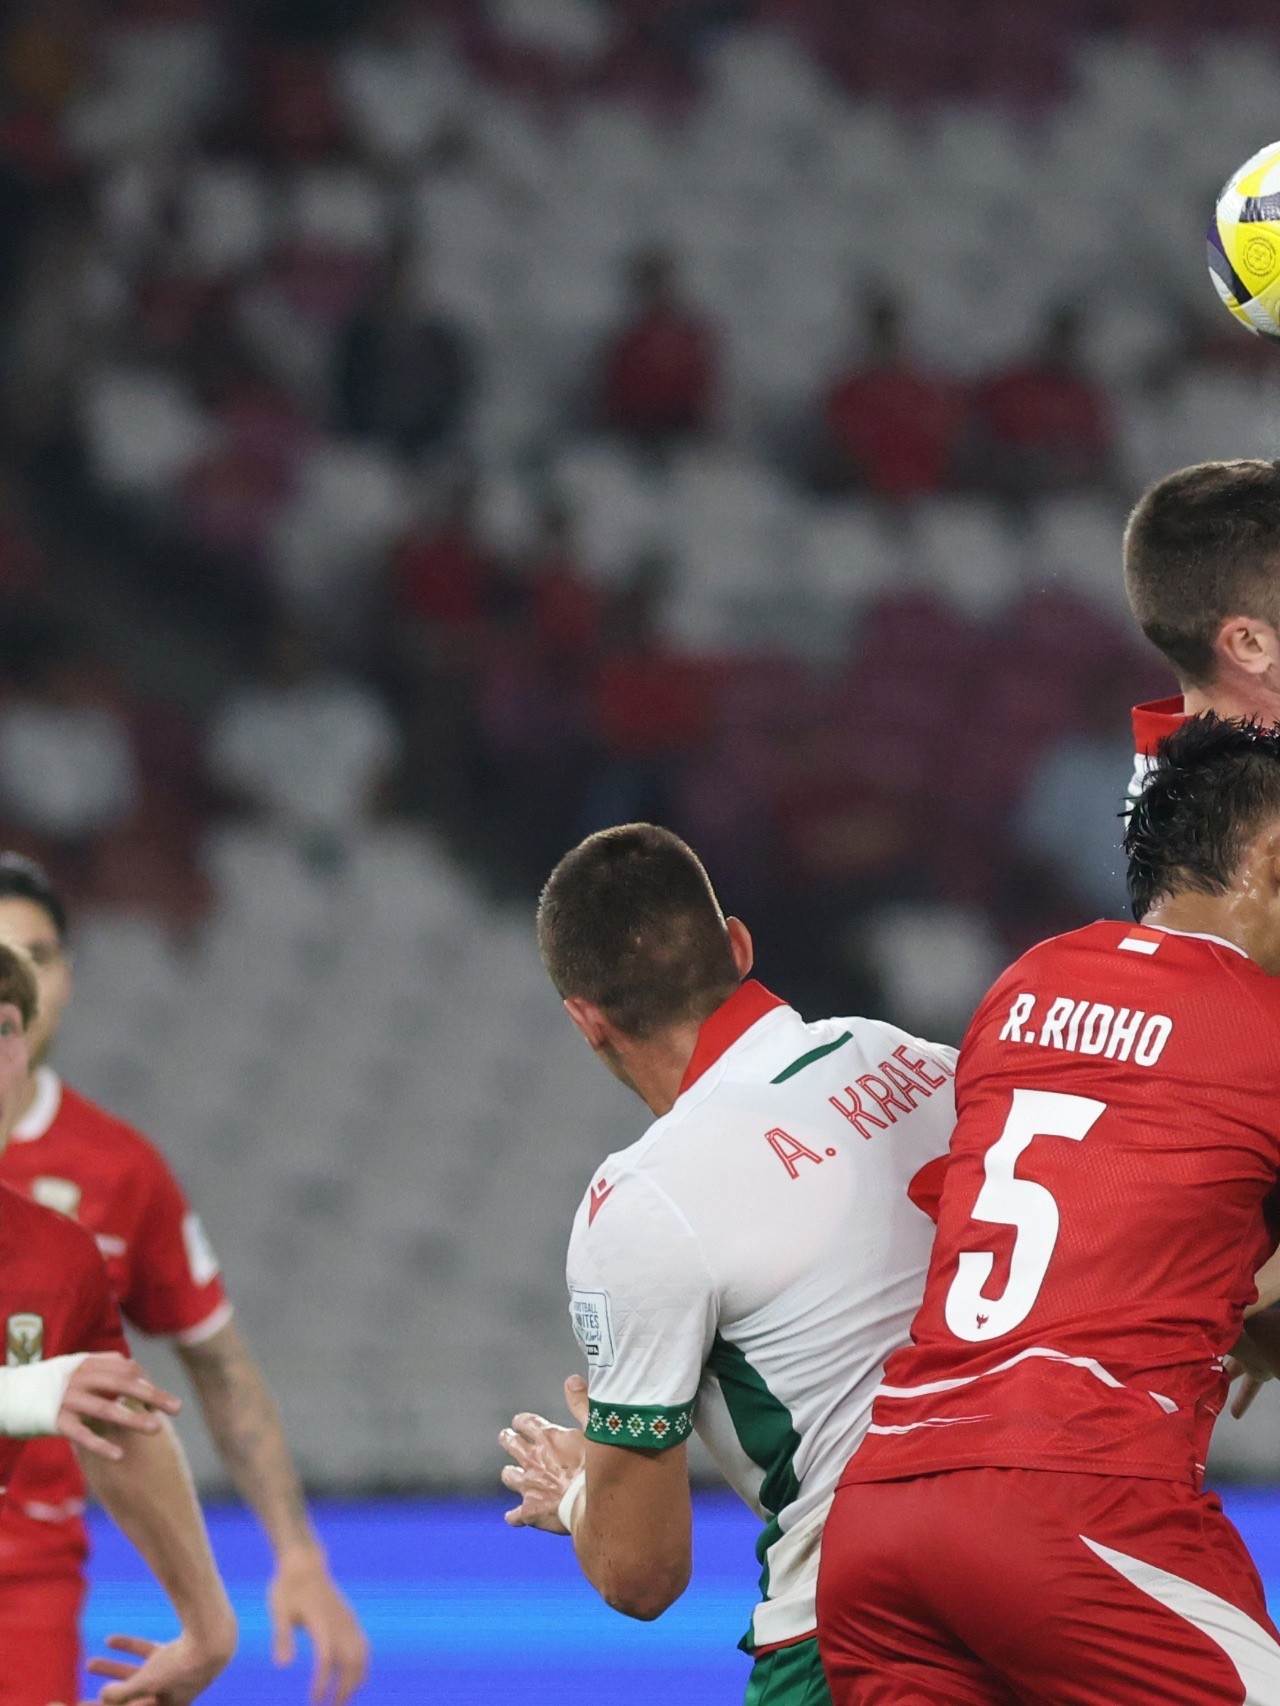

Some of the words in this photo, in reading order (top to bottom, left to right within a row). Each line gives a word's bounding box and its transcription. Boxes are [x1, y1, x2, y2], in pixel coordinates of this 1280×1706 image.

[998, 993, 1174, 1068] R.RIDHO
[764, 1127, 836, 1180] A.
[828, 1044, 955, 1140] KRAE
[944, 1087, 1108, 1343] 5
